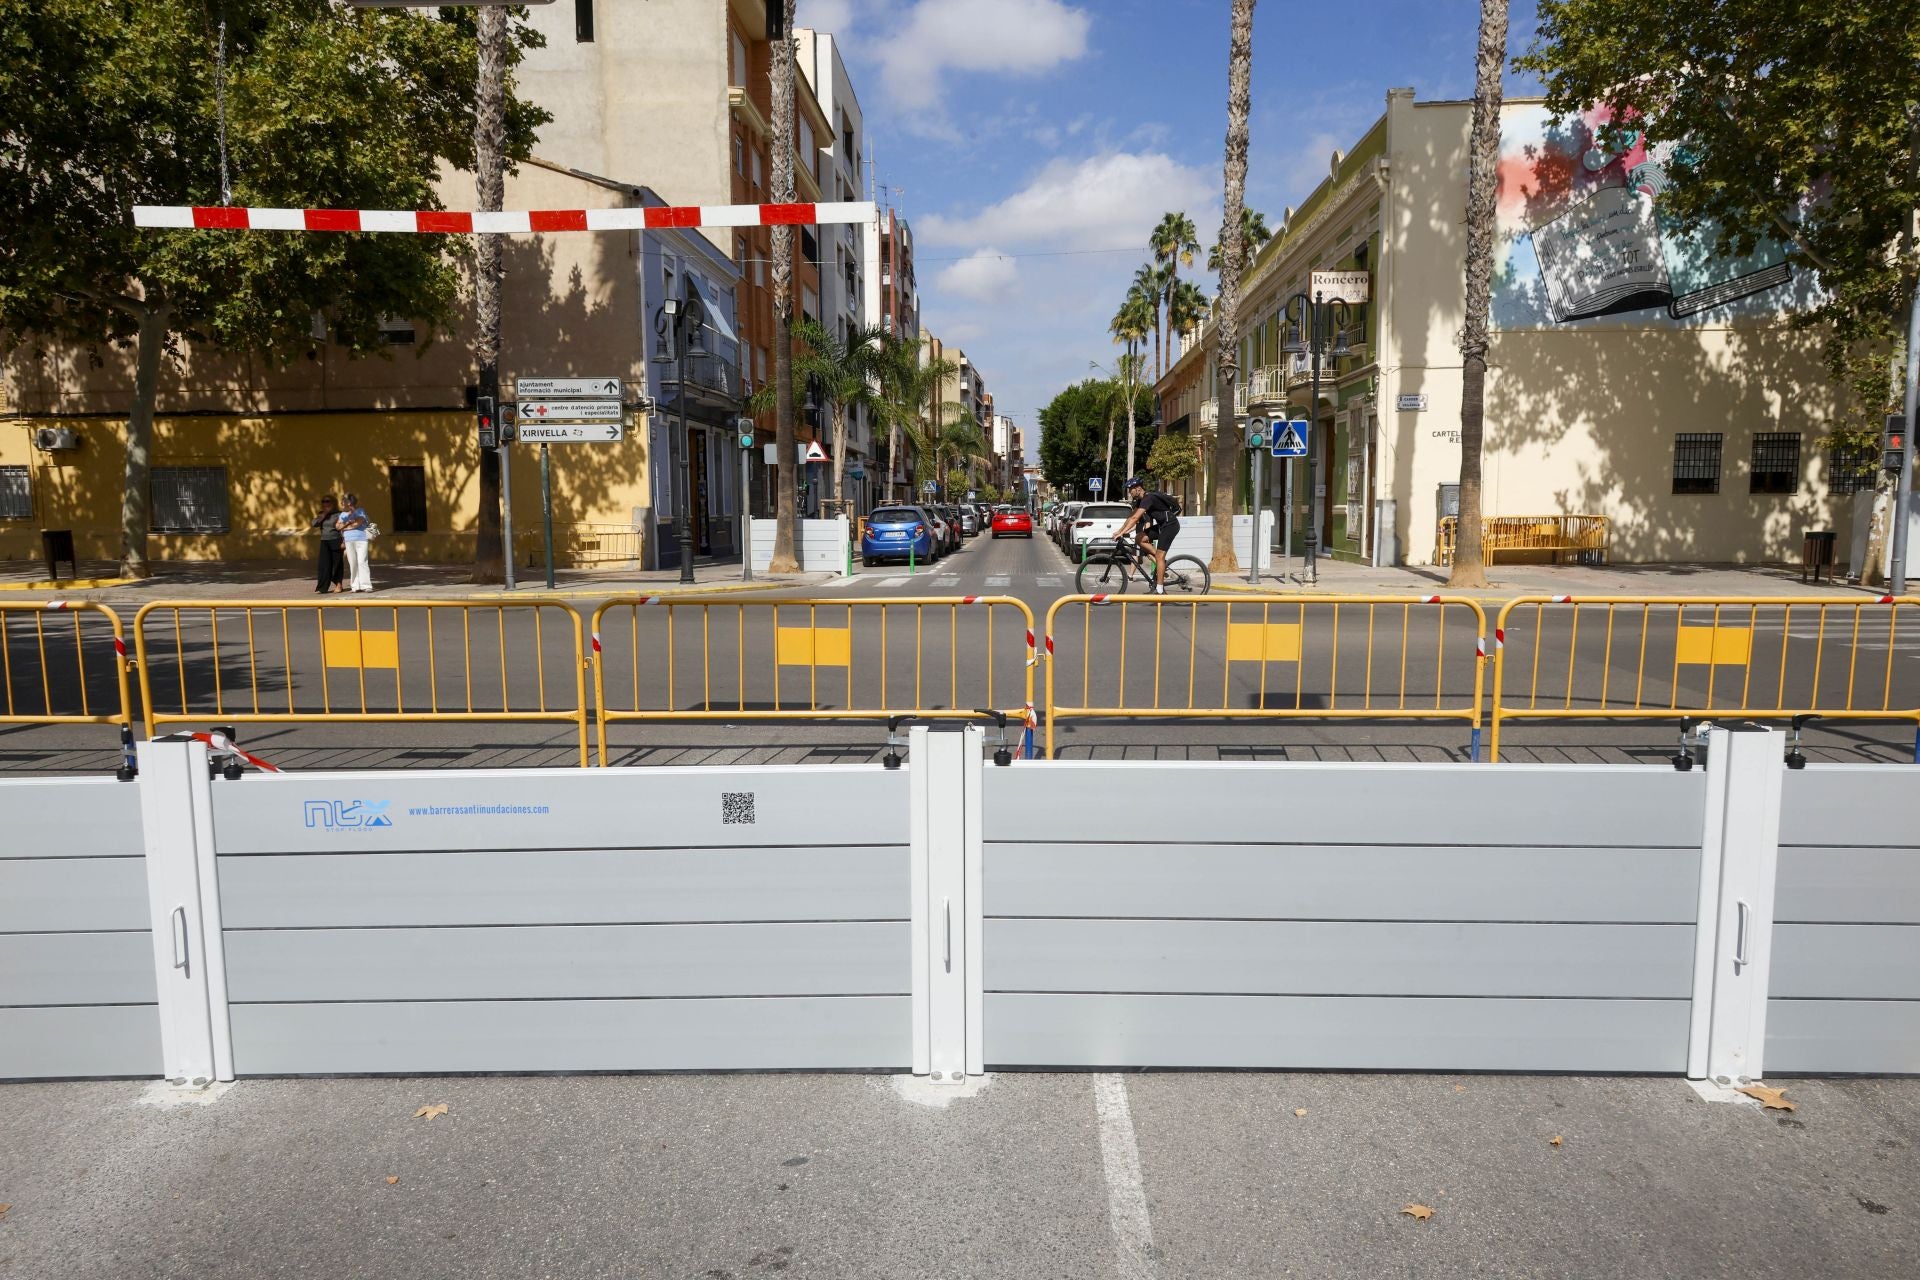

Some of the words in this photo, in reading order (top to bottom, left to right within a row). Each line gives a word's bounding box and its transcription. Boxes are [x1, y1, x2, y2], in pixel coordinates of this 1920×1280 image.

[1620, 249, 1641, 265] TOT
[1313, 274, 1368, 285] Roncero
[522, 429, 568, 437] XIRIVELLA
[408, 804, 550, 816] www.barrerasantiinundaciones.com
